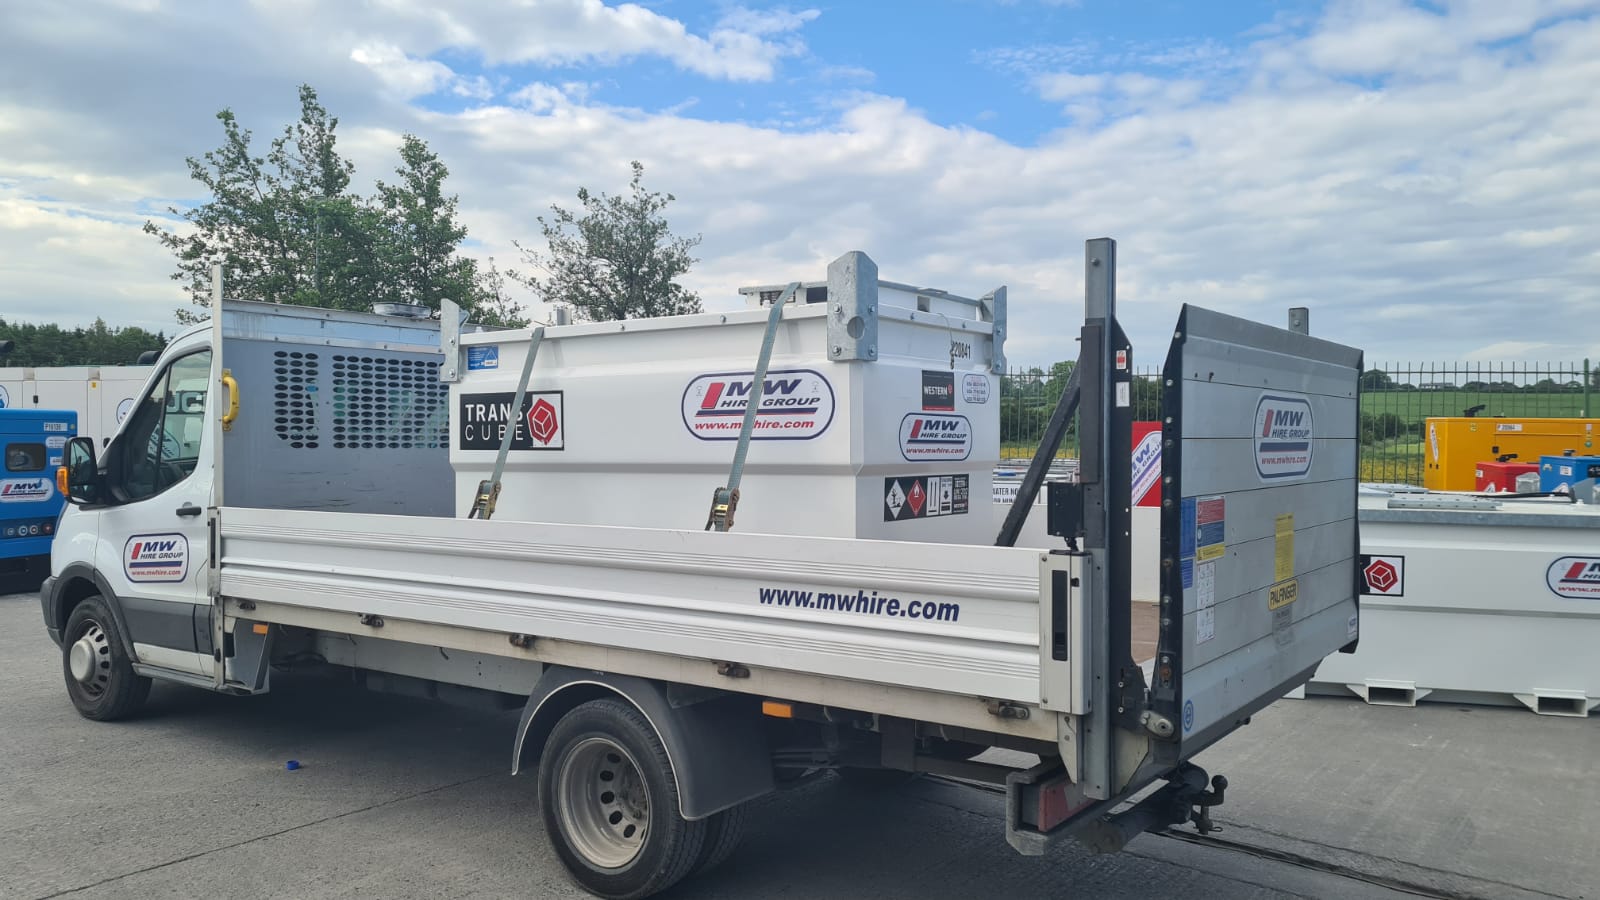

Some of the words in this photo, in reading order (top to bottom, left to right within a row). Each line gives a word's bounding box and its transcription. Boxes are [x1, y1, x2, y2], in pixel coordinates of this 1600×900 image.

[726, 379, 803, 396] MW
[923, 385, 948, 396] WESTERN
[720, 399, 750, 408] HIR
[761, 397, 821, 407] GROUP
[1274, 409, 1304, 427] MW
[694, 419, 814, 430] www.mhire.com
[923, 419, 959, 431] MW
[465, 424, 524, 441] CUBE
[1271, 428, 1288, 438] HIRE
[1288, 429, 1310, 438] GROUP
[1261, 456, 1307, 465] www.mwhire.com
[143, 540, 177, 552] MW
[759, 587, 961, 622] www.mwhire.com
